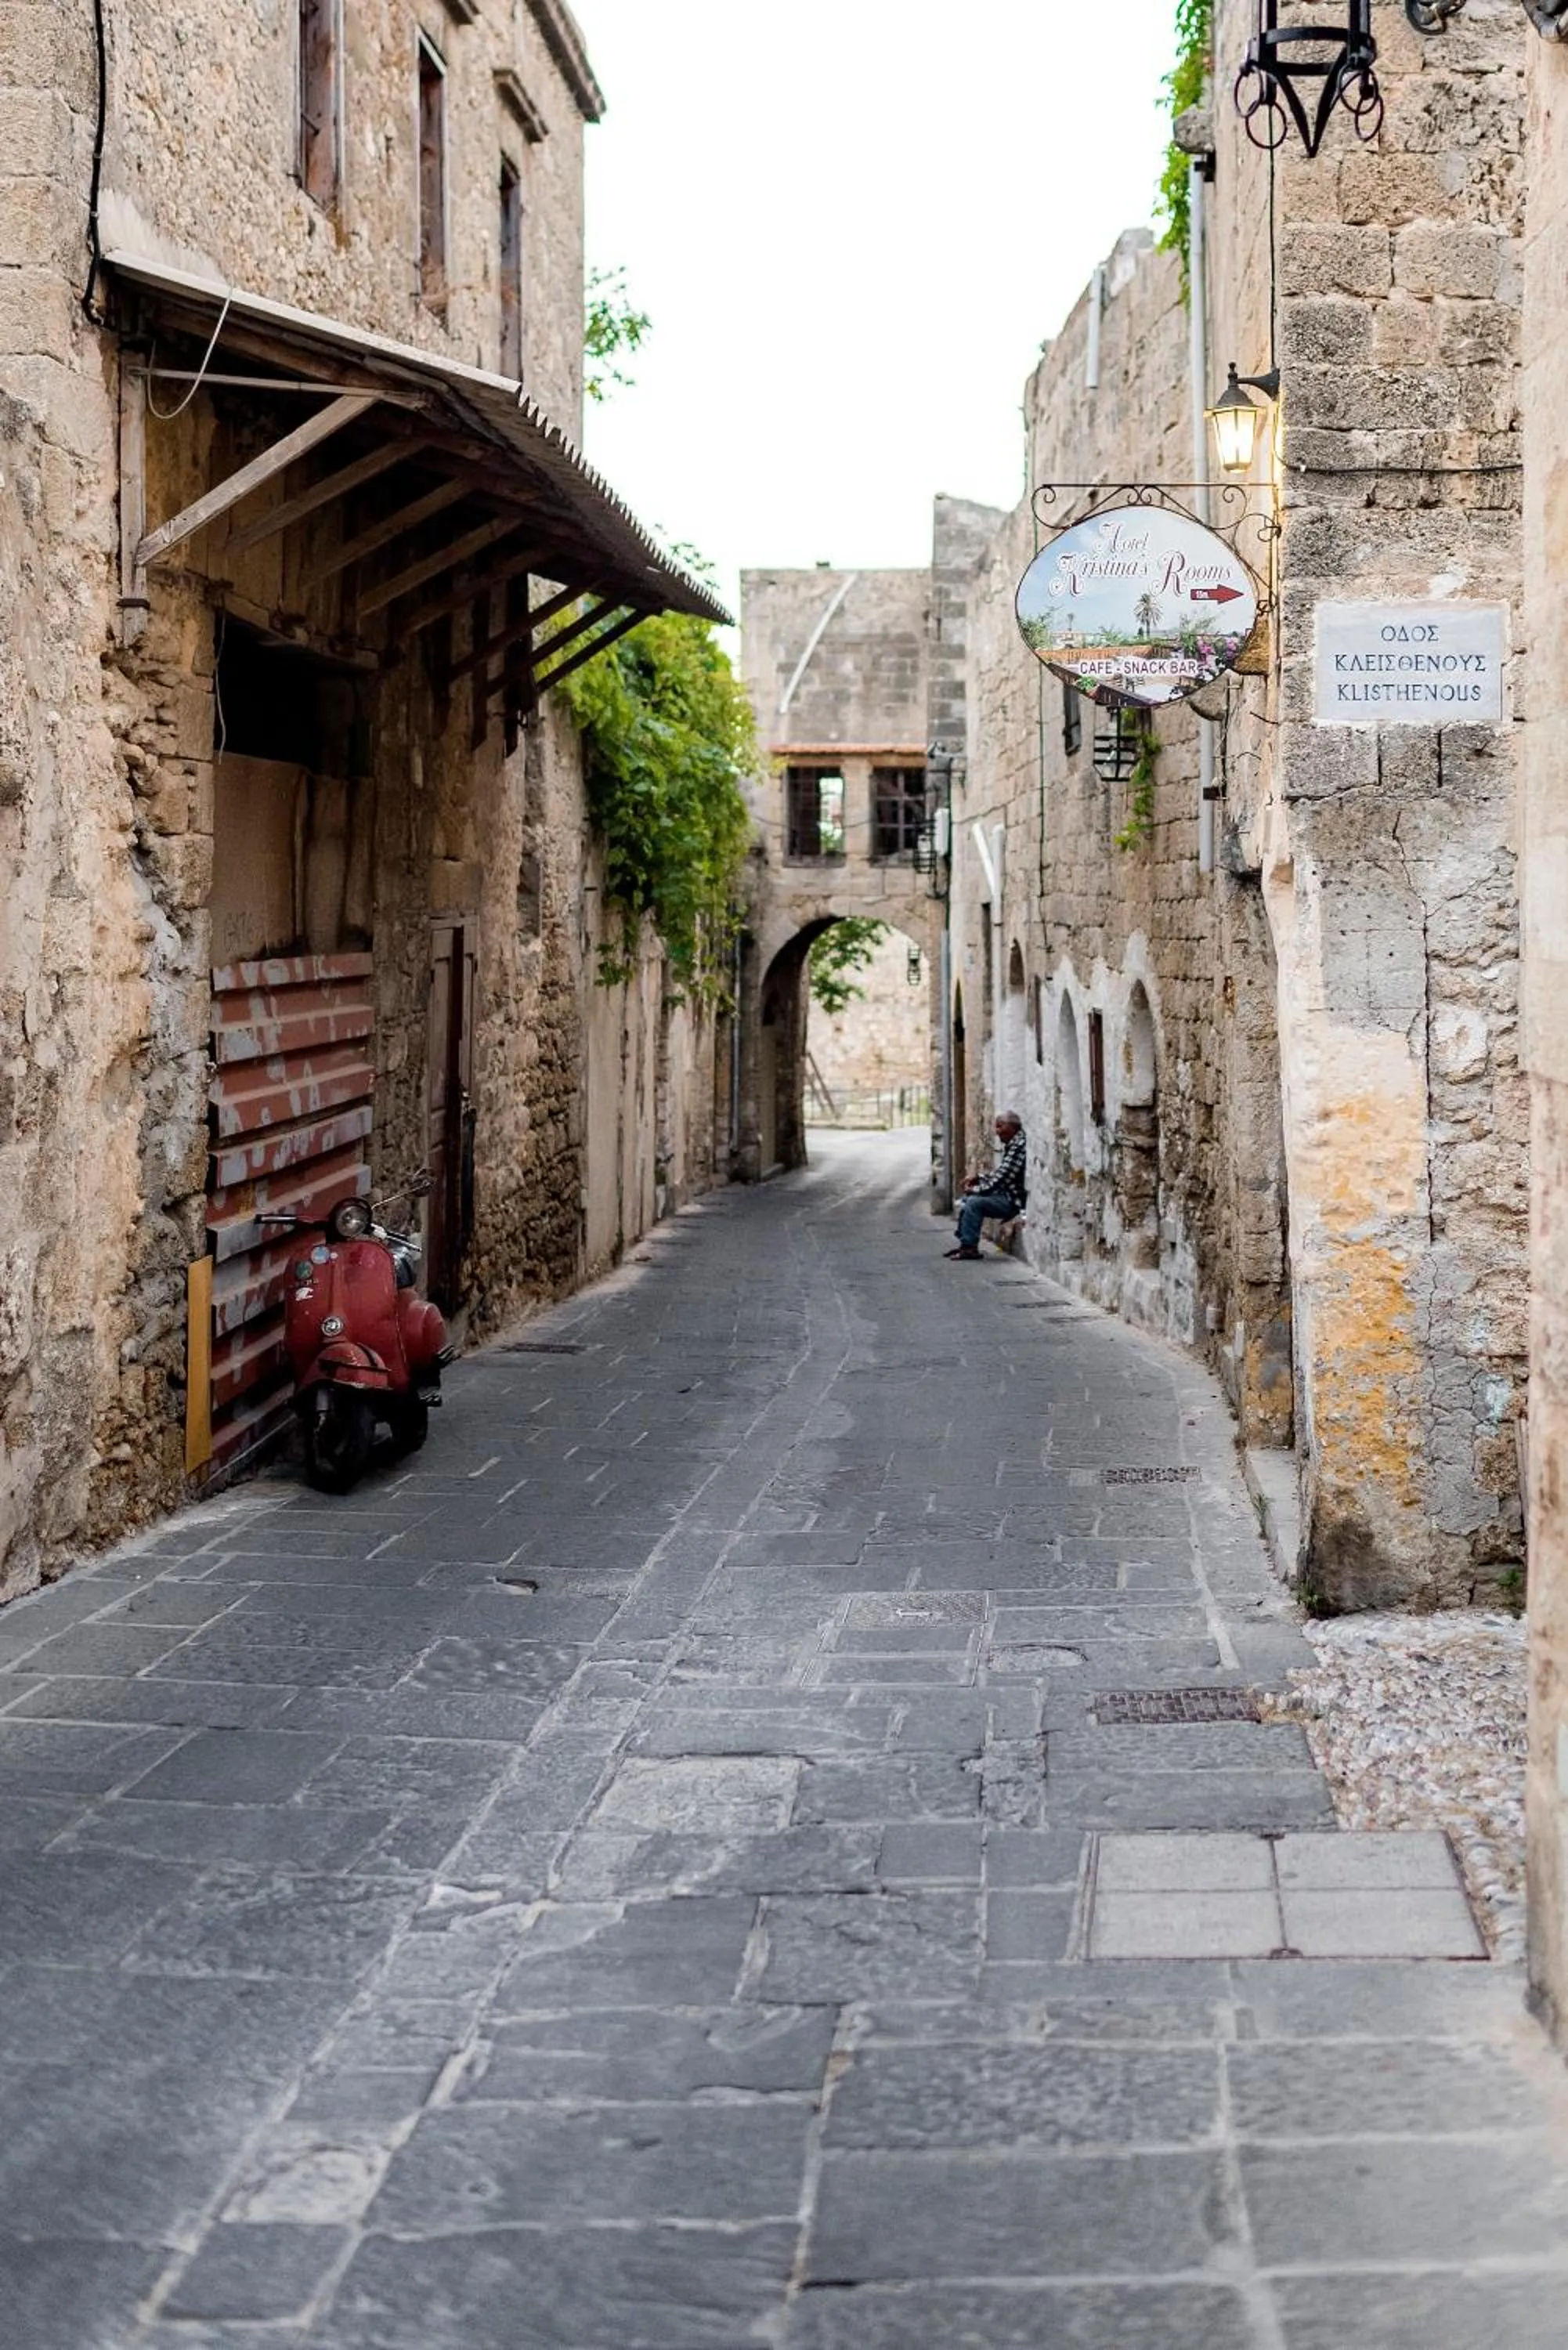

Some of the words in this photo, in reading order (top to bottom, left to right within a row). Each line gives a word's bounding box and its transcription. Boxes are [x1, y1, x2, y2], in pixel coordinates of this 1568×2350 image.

[1094, 522, 1149, 553] Hotel
[1152, 550, 1231, 597] Rooms
[1381, 625, 1440, 642] ΟΔΟΣ
[1080, 660, 1113, 675] CAFE
[1124, 660, 1167, 675] SNACK
[1170, 660, 1196, 674] BAR
[1335, 654, 1486, 672] ΚΛΕΙΣΘΕΝΟΥΣ
[1337, 684, 1481, 701] KLISTHENOUS
